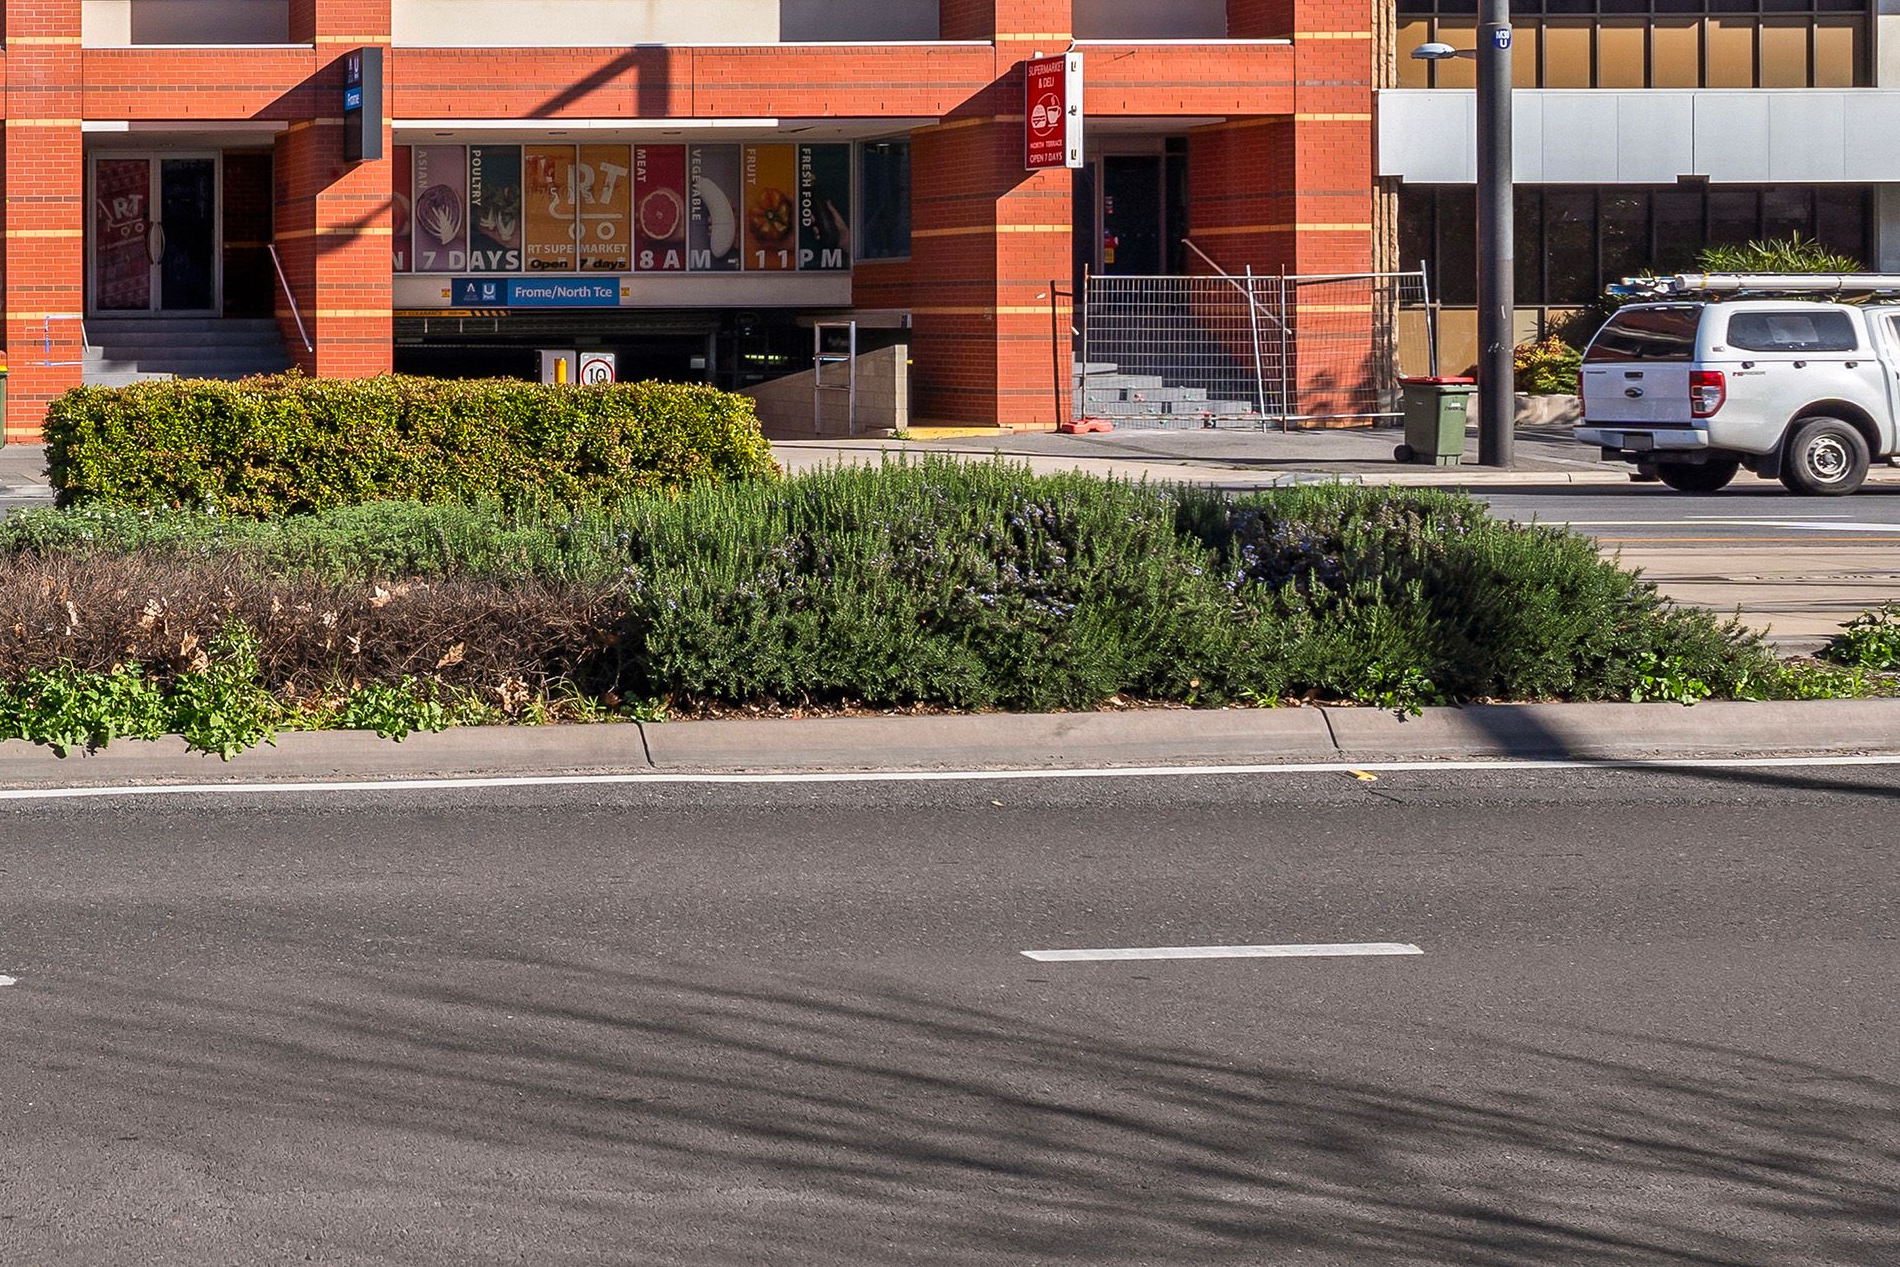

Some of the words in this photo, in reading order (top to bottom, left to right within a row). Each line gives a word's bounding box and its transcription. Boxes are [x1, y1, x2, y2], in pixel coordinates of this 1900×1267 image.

[1028, 61, 1064, 76] SUPERMARKET
[1043, 77, 1054, 88] DELI
[637, 149, 646, 182] MEAT
[747, 148, 757, 185] FRUIT
[802, 148, 811, 187] FRESH
[1029, 154, 1043, 163] OPEN
[1048, 152, 1063, 162] DAYS
[418, 150, 428, 188] ASIAN
[471, 149, 482, 206] POULTRY
[692, 149, 701, 221] VEGETABLE
[802, 191, 812, 227] FOOD
[528, 244, 542, 254] RT
[544, 244, 628, 254] SUPEMARKET
[422, 251, 437, 270] 7
[448, 250, 520, 270] DAYS
[530, 259, 568, 270] Open
[593, 259, 626, 270] days
[515, 285, 591, 299] Frome/North
[594, 286, 613, 298] Tce
[589, 368, 607, 384] 10
